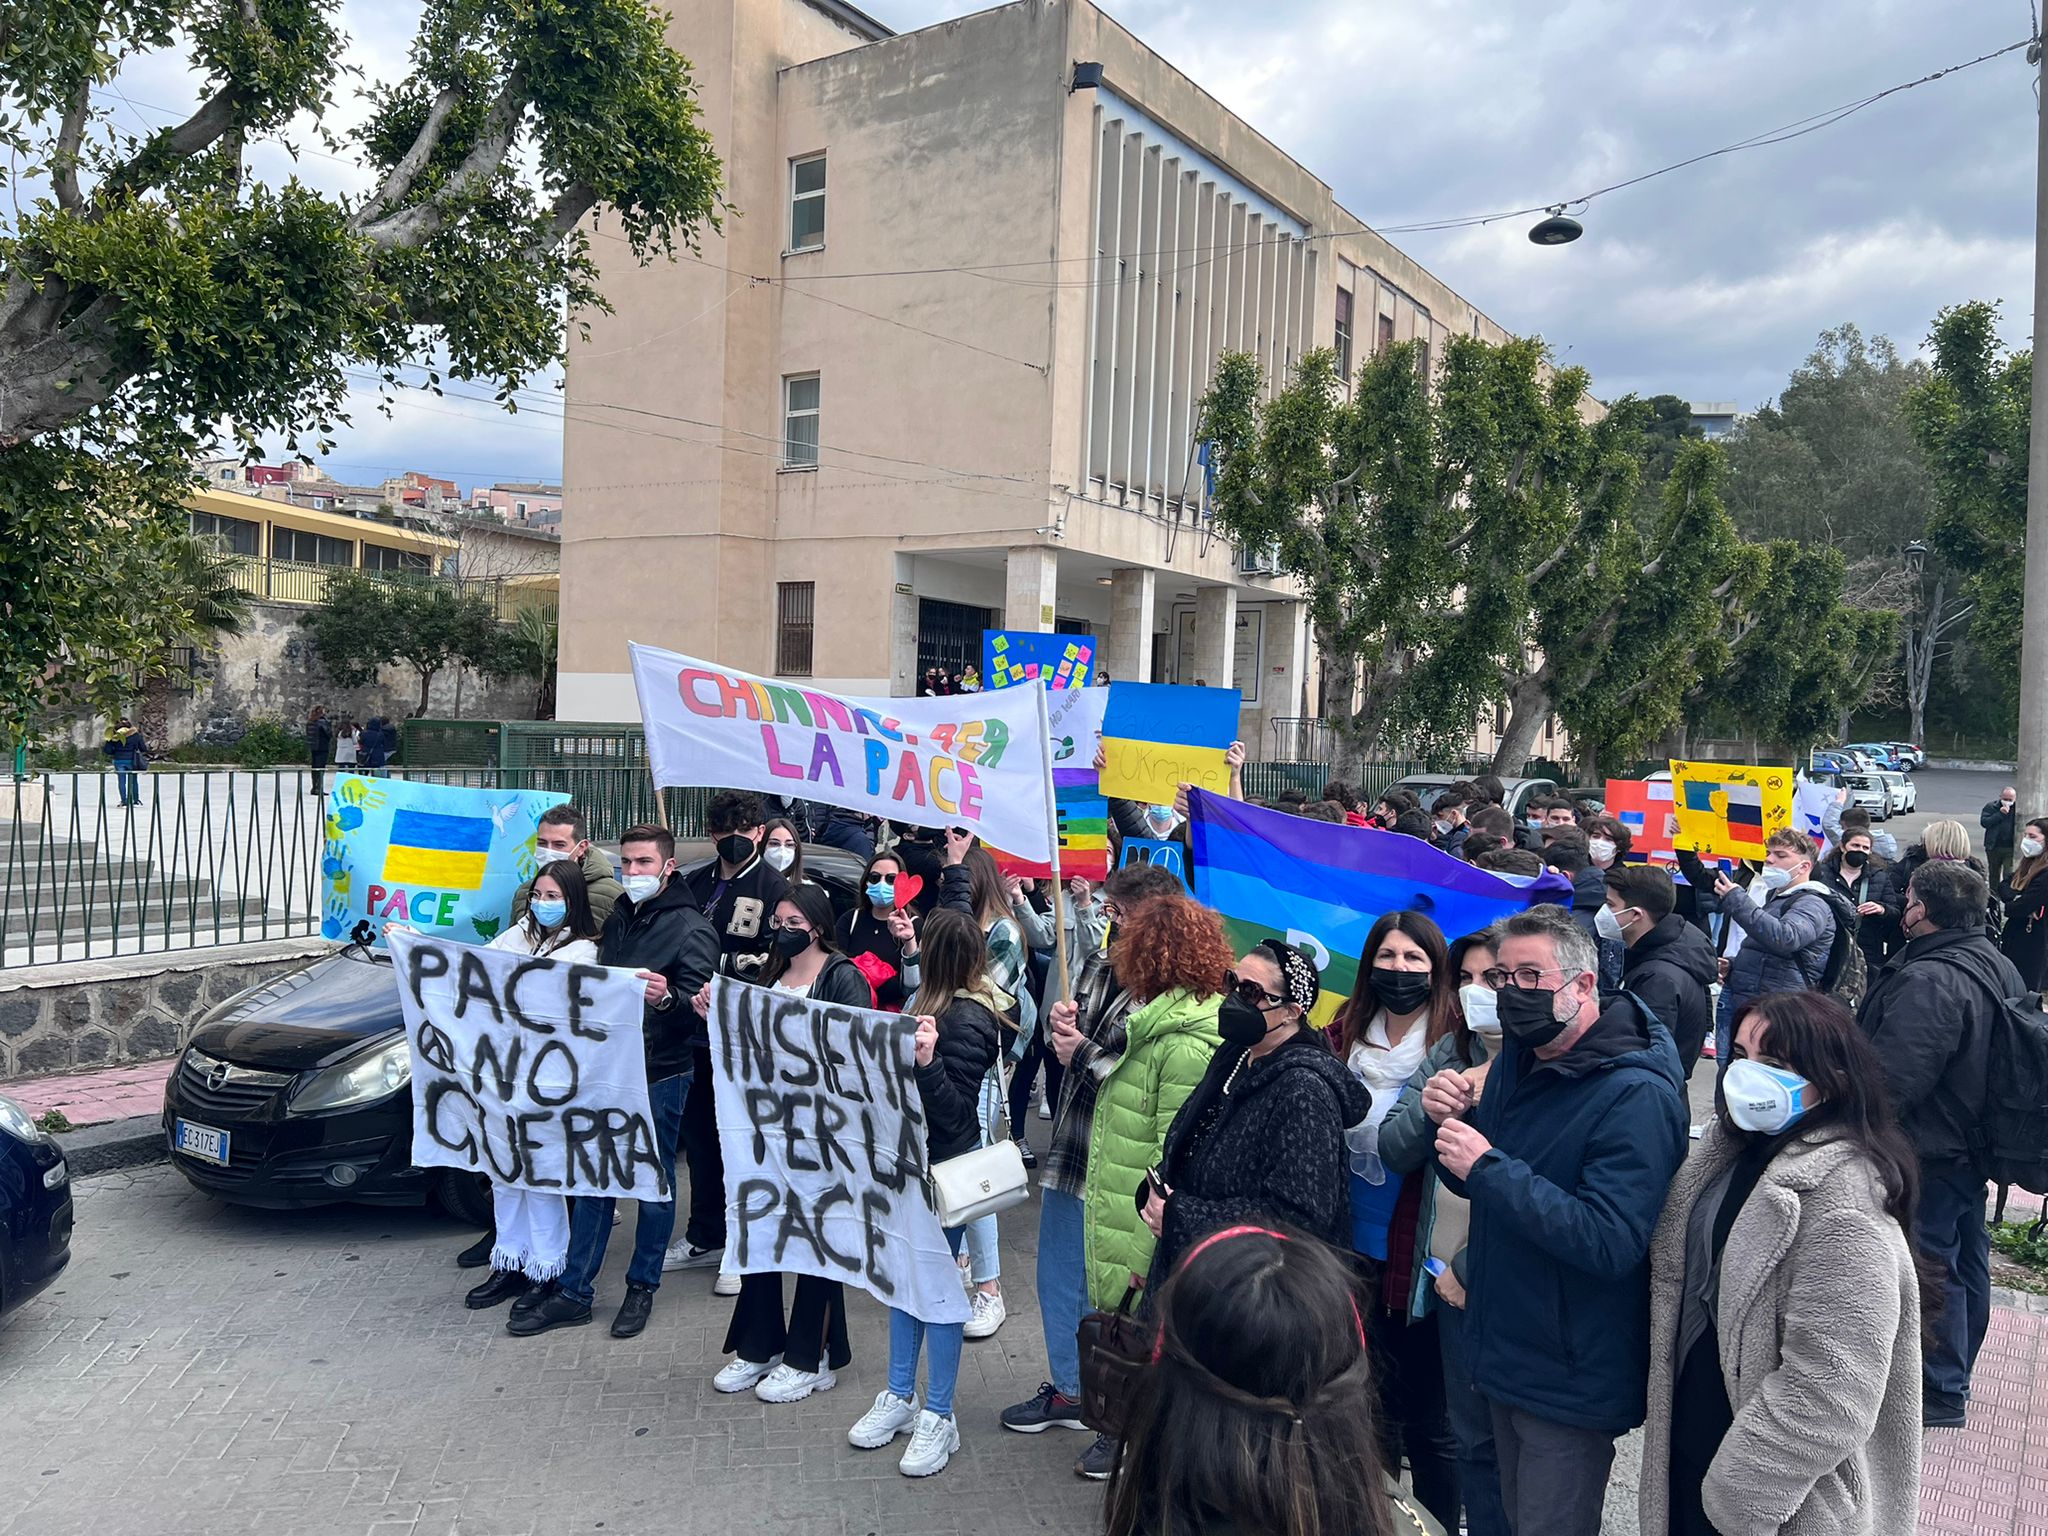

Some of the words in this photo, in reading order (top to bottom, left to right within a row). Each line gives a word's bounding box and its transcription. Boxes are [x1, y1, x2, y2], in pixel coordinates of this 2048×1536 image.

[760, 724, 844, 788] LA
[864, 738, 984, 822] PACE
[366, 884, 460, 927] PACE
[409, 945, 609, 1041] PACE
[471, 1033, 578, 1106] NO
[717, 977, 922, 1125] INSIEME
[425, 1077, 670, 1196] GUERRA
[737, 1178, 895, 1296] PACE
